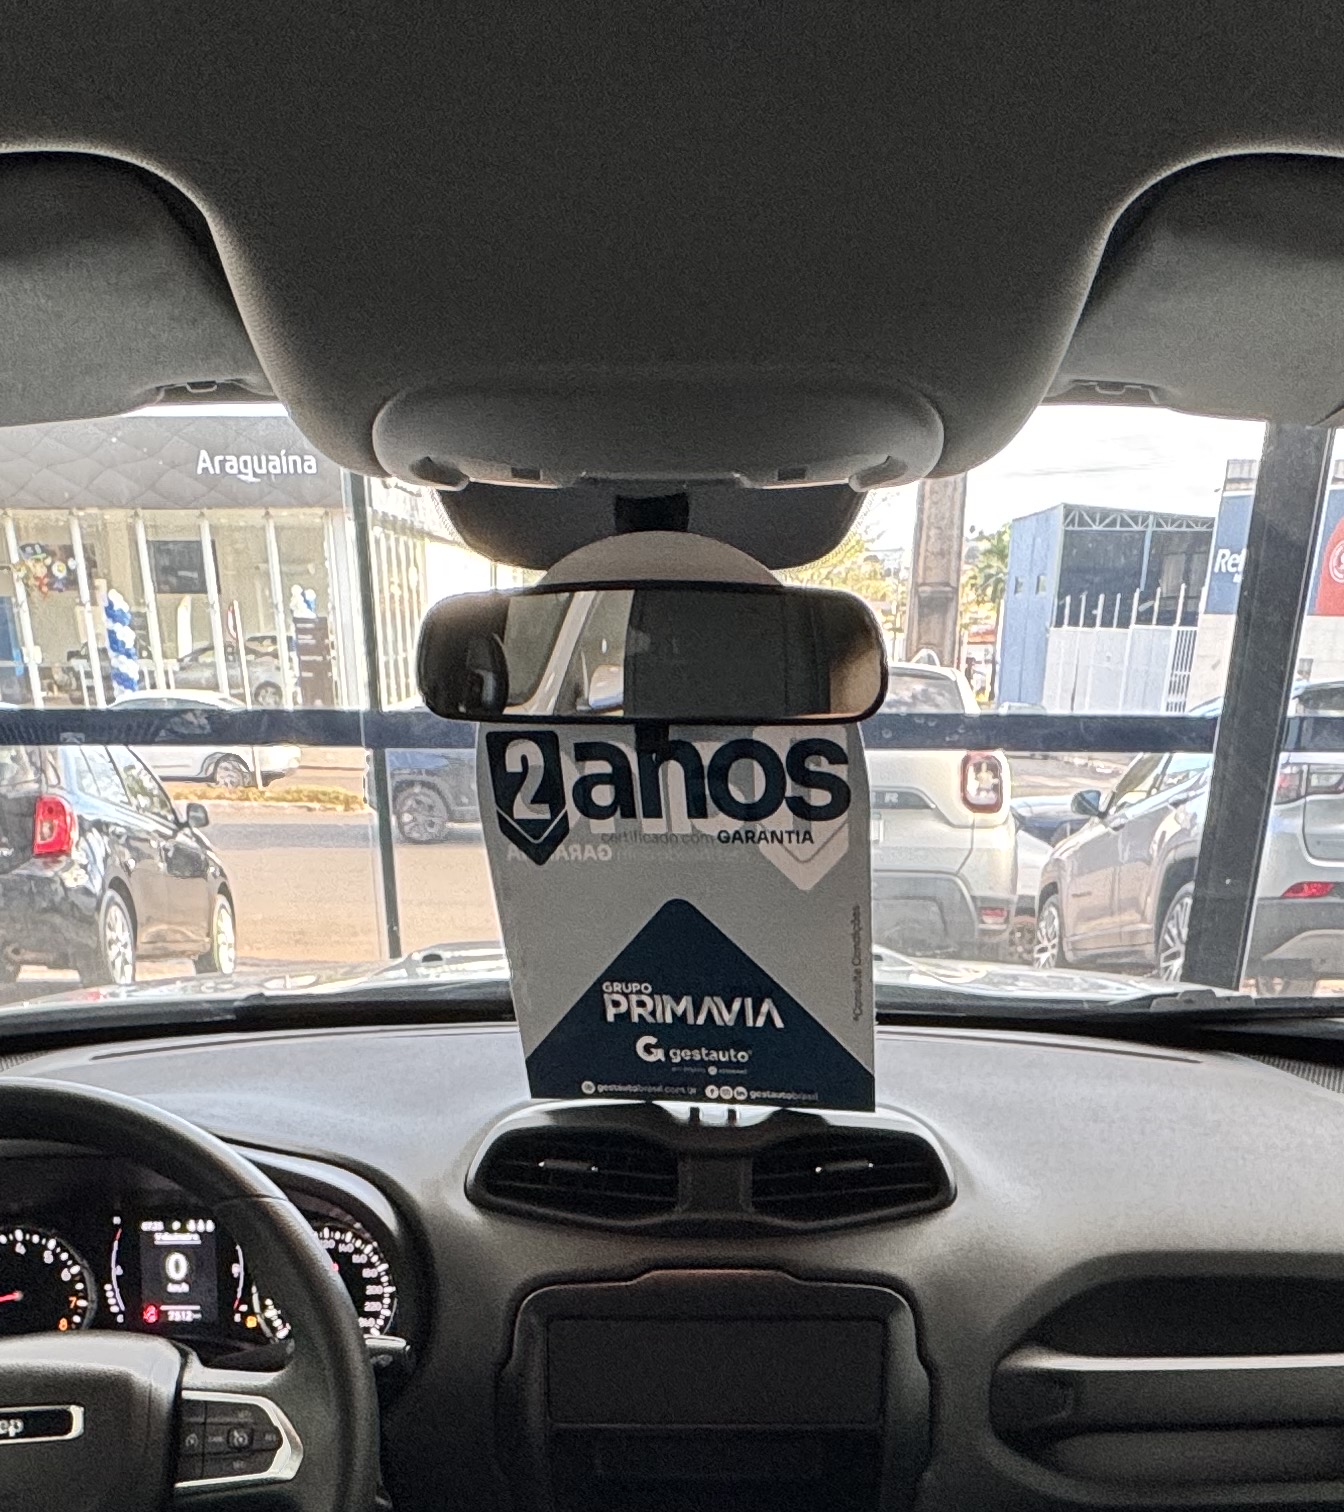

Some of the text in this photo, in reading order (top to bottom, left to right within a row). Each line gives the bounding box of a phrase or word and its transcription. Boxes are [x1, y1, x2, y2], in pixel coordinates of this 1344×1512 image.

[197, 449, 317, 482] Araguaína
[504, 737, 852, 822] 2 anos
[716, 829, 815, 846] GARANTIA
[602, 981, 652, 994] GRUPO
[603, 993, 785, 1029] PRIMAVIA
[668, 1047, 749, 1064] gestauto
[165, 1252, 188, 1281] 0
[68, 1296, 77, 1309] 7
[58, 1317, 68, 1332] 8
